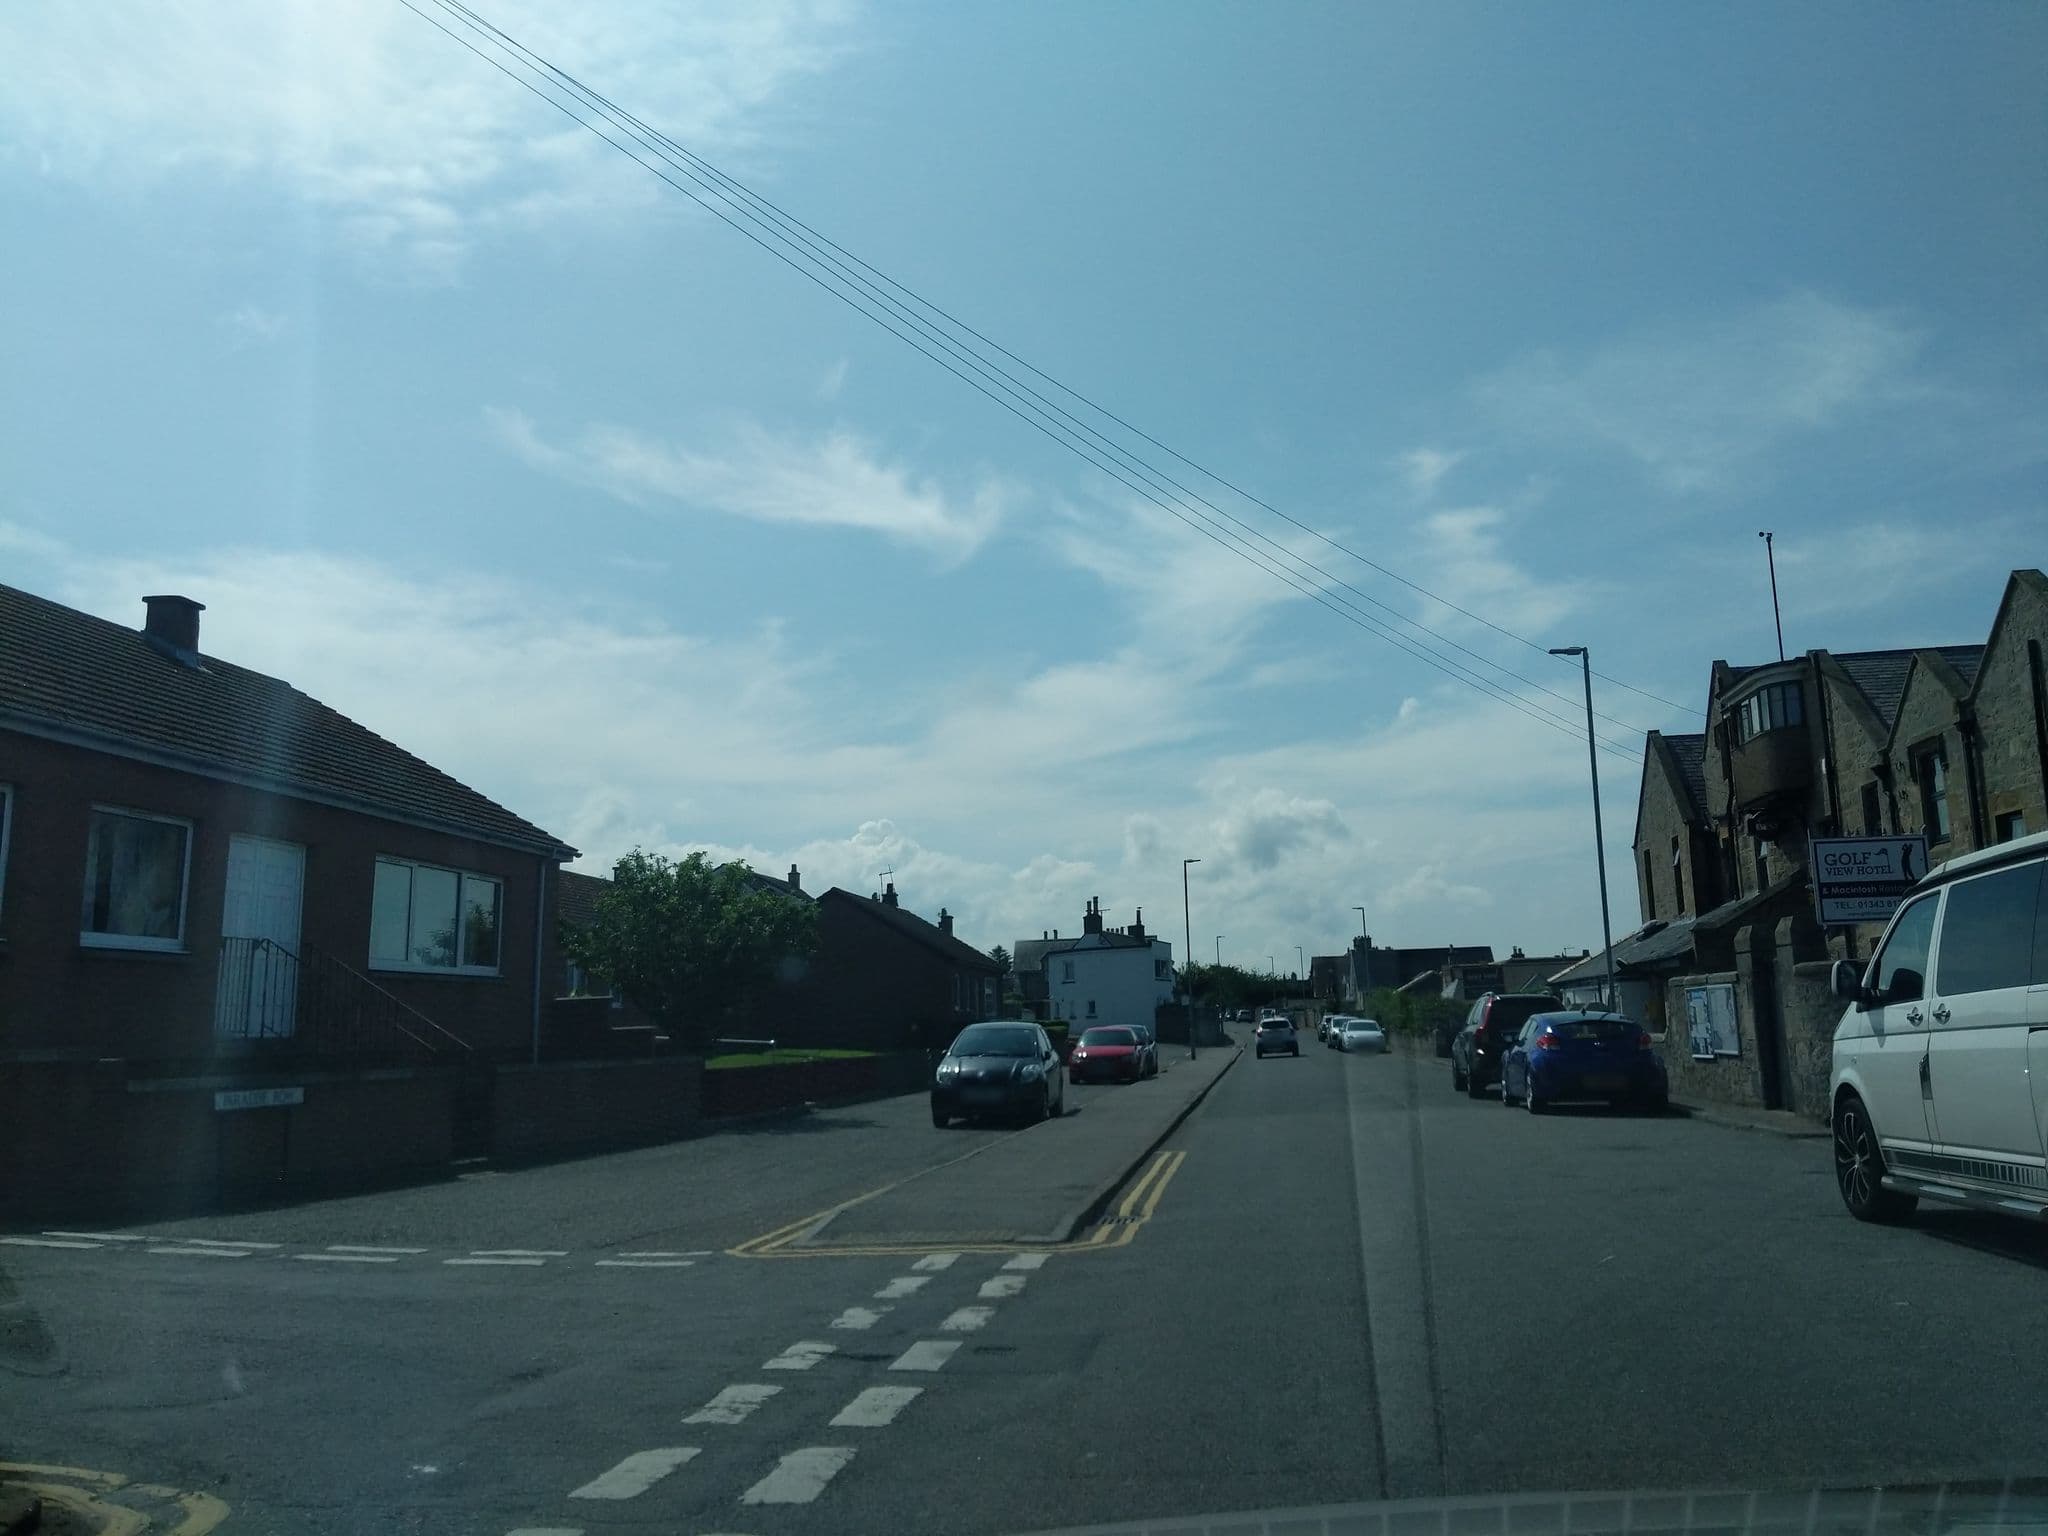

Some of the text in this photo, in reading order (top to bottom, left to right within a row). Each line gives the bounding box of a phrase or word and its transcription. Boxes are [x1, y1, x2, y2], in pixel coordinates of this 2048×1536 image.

[1824, 852, 1872, 866] GOLF
[1825, 865, 1894, 876] VIEW HOTEL
